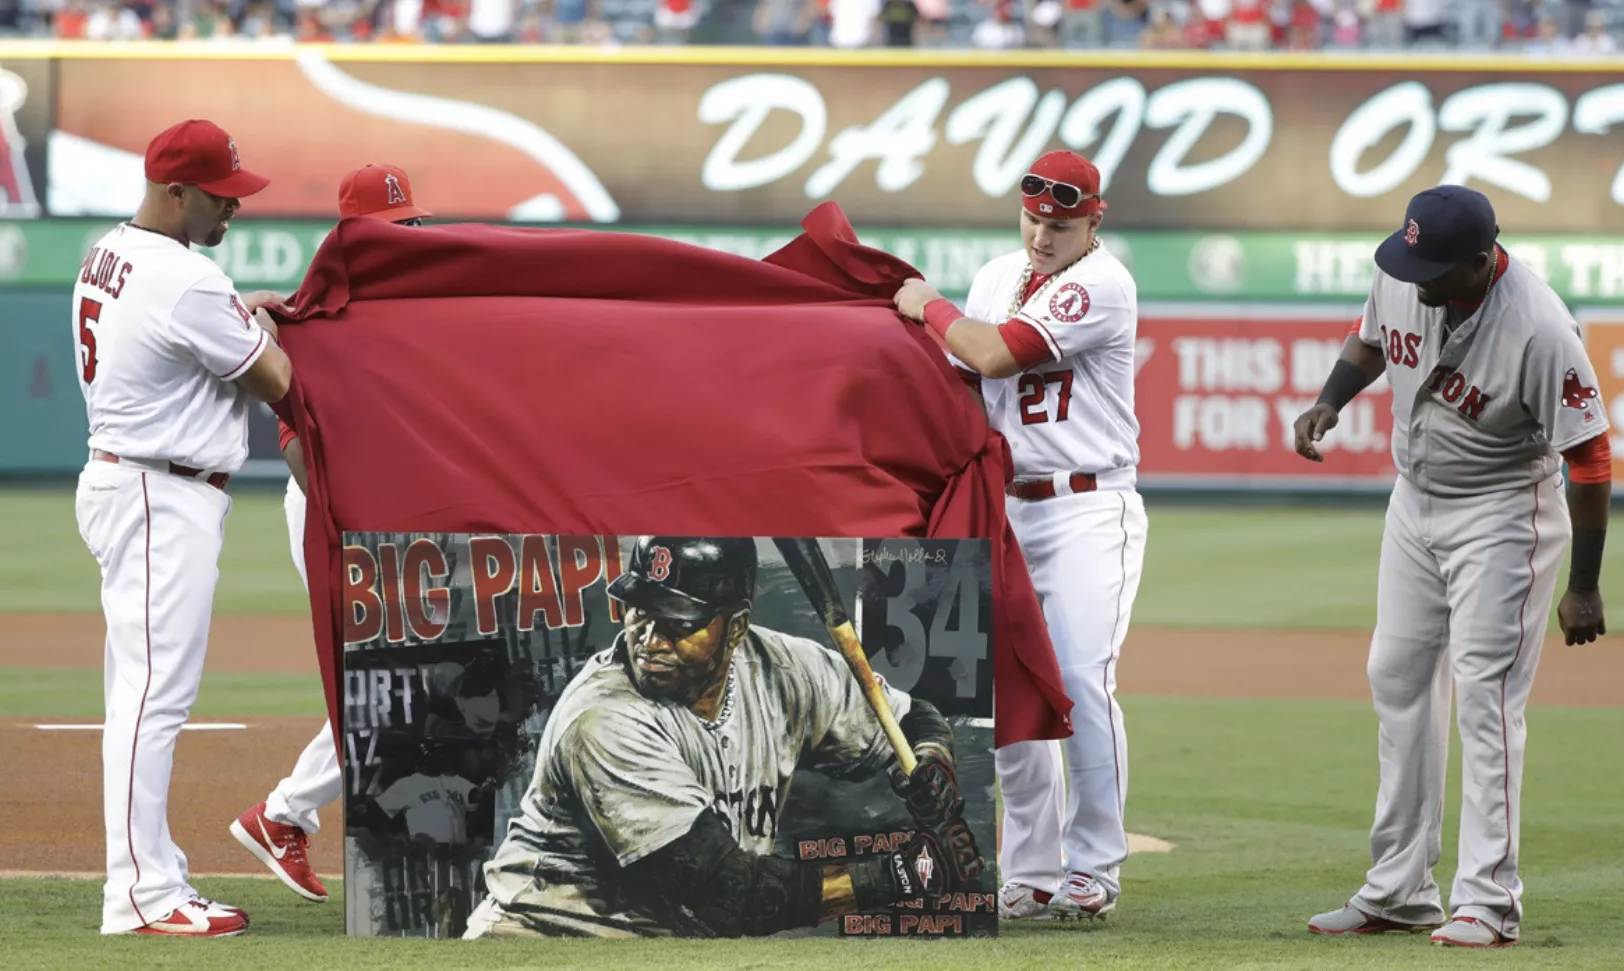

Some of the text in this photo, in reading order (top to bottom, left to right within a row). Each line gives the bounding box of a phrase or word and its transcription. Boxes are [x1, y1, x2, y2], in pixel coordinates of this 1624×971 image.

[698, 73, 1273, 198] DAVID
[385, 173, 406, 204] A
[1404, 218, 1420, 246] B
[79, 296, 103, 385] 5
[1171, 336, 1286, 394] THIS
[1018, 369, 1073, 426] 27
[1172, 394, 1269, 451] FOR
[343, 538, 450, 645] BIG
[647, 545, 673, 581] B
[868, 539, 988, 699] 34
[799, 837, 847, 861] BIG
[844, 914, 964, 935] BIG PAPI
